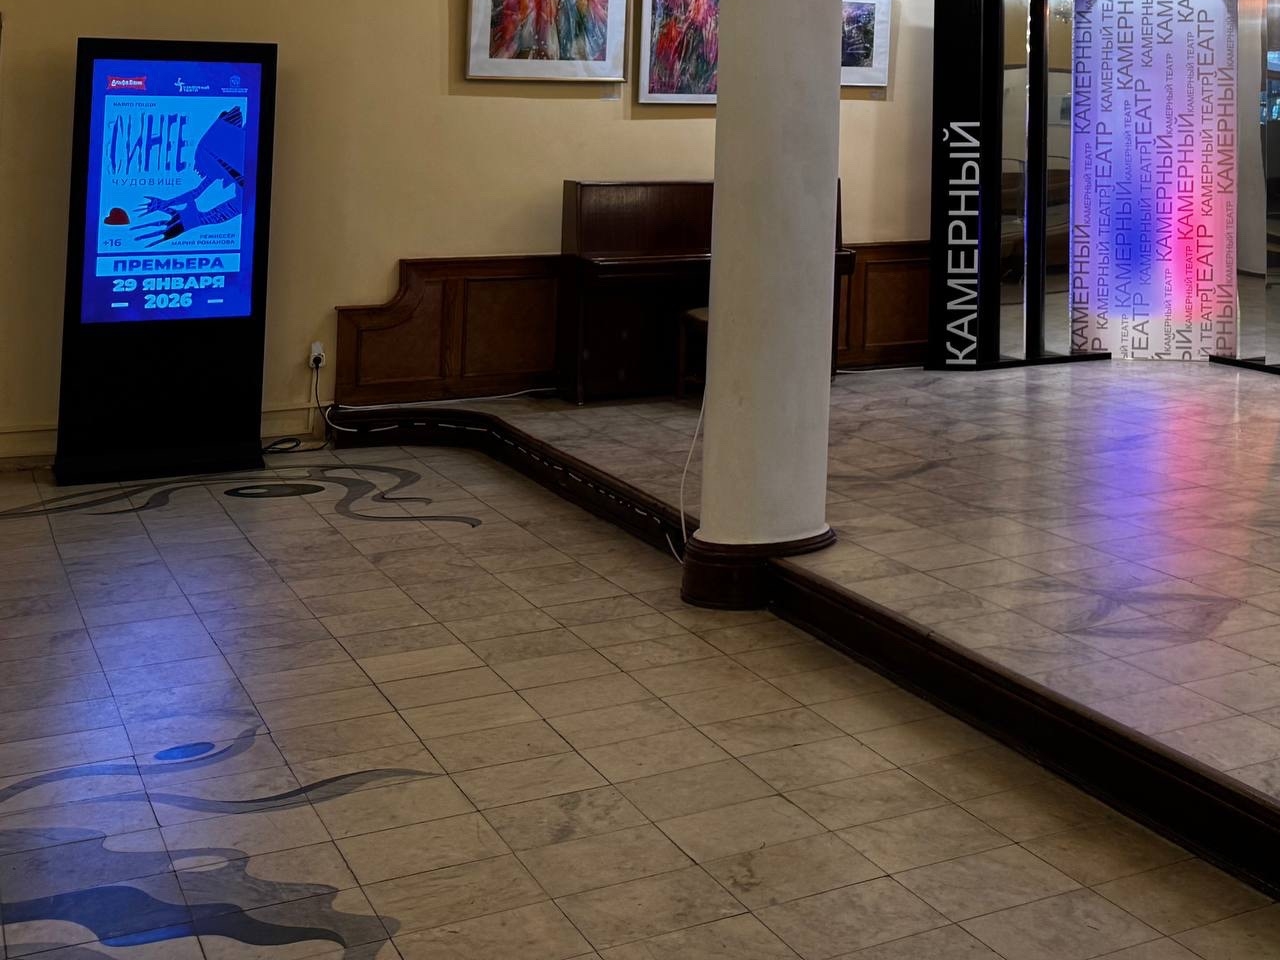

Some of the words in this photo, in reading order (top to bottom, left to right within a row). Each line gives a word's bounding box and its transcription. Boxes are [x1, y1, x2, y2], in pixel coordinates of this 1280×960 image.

[1166, 53, 1174, 82] ТЕАТР
[1187, 31, 1195, 61] ТЕАТР
[1197, 9, 1215, 81] ТЕАТР
[1099, 28, 1114, 113] КАМЕРНЫЙ
[1124, 100, 1133, 129] ТЕАТР
[1134, 78, 1153, 150] ТЕАТР
[1201, 75, 1214, 125] ТЕАТР
[1213, 67, 1235, 194] КАМЕРНЫЙ
[112, 177, 182, 187] ЧУДОВИЩЕ
[1095, 121, 1113, 194] ТЕАТР
[1139, 144, 1152, 193] ТЕАТР
[1174, 113, 1195, 240] КАМЕРНЫЙ
[1200, 128, 1214, 217] КАМЕРНЫЙ
[1098, 189, 1111, 237] ТЕАТР
[1151, 134, 1173, 262] КАМЕРНЫЙ
[1226, 200, 1234, 230] ТЕАТР
[103, 238, 122, 247] +16
[113, 256, 225, 273] ПРЕМЬЕРА
[942, 121, 980, 365] КАМЕРНЫЙ
[1111, 181, 1133, 308] КАМЕРНЫЙ
[1137, 196, 1151, 286] КАМЕРНЫЙ
[1185, 245, 1193, 276] ТЕАТР
[1196, 224, 1214, 298] ТЕАТР
[112, 278, 137, 292] 29
[142, 275, 225, 291] ЯНВАРЯ
[144, 292, 192, 309] 2026
[1096, 240, 1110, 330] КАМЕРНЫЙ
[1165, 268, 1173, 298] ТЕАТР
[1120, 313, 1129, 344] ТЕАТР
[1200, 294, 1213, 342] ТЕАТР
